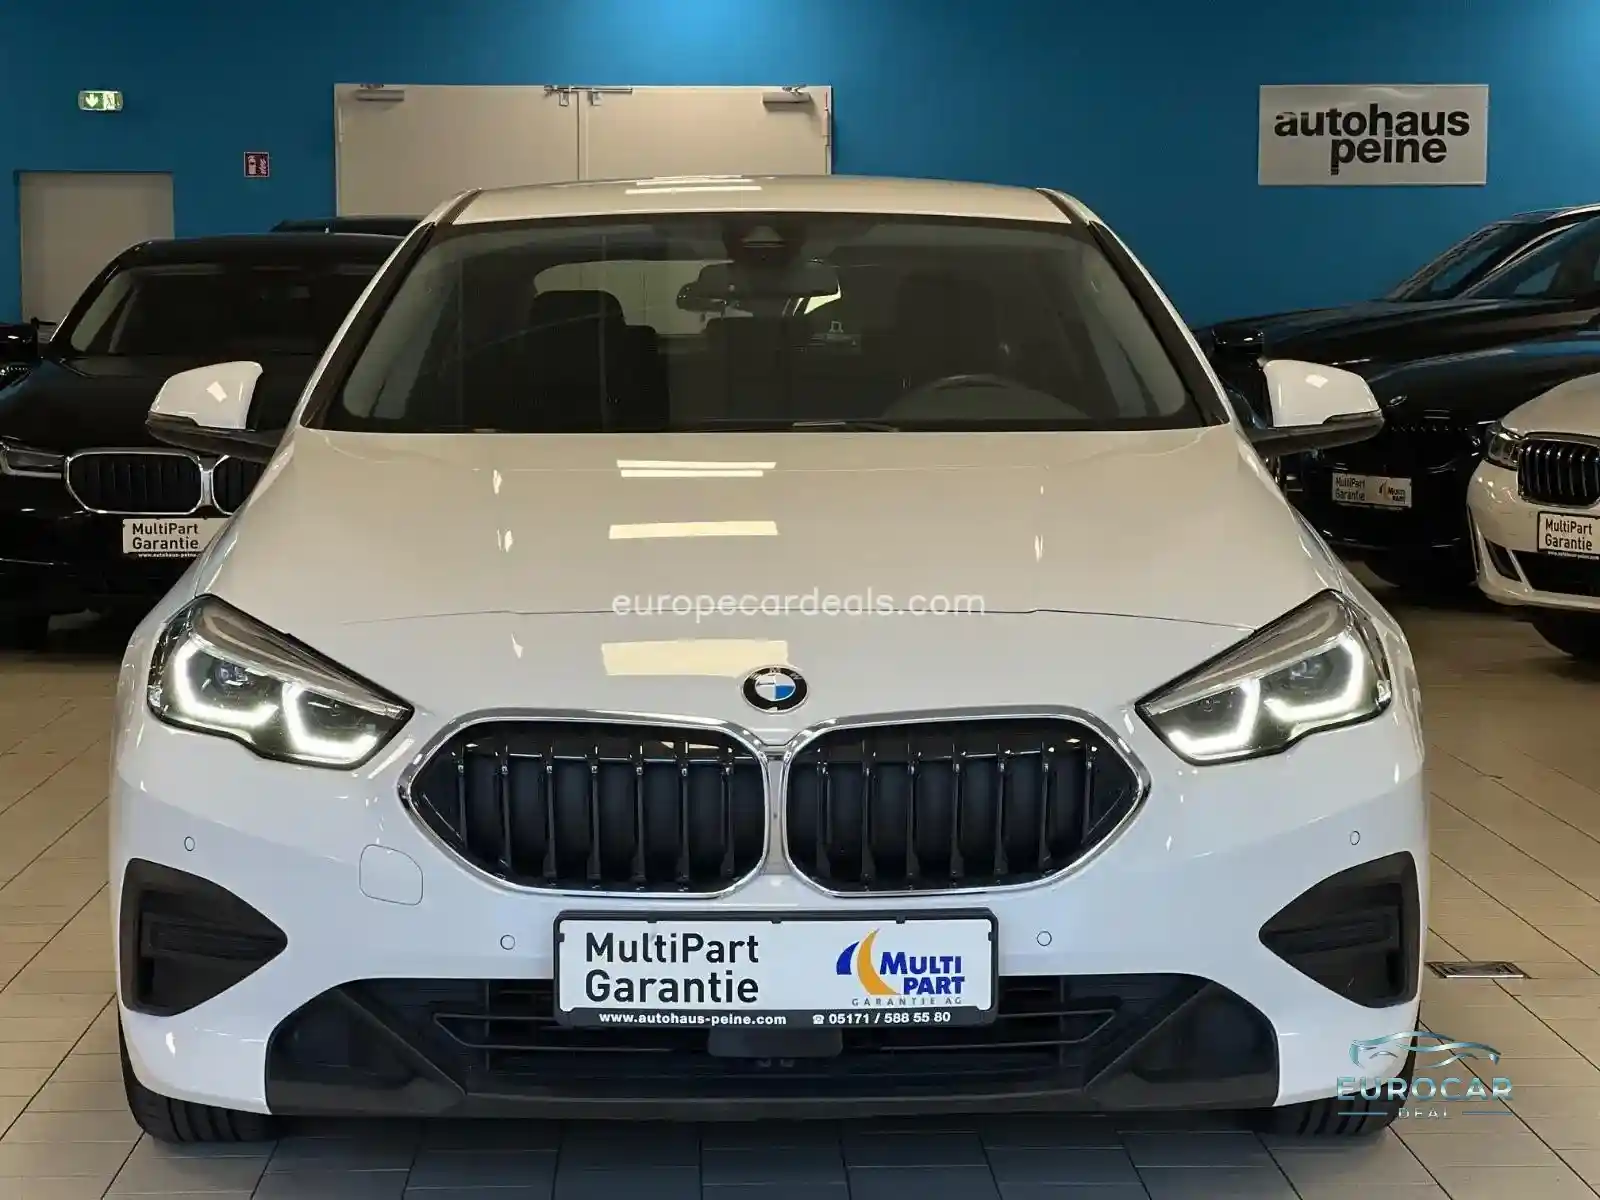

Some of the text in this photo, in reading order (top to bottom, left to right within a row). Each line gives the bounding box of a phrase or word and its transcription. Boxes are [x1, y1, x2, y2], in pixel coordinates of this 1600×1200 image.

[1274, 103, 1470, 137] autohaus
[1331, 135, 1447, 175] peine
[132, 522, 199, 535] MultiPart
[1545, 518, 1592, 535] MultiPart
[132, 536, 199, 549] Garantie
[1545, 533, 1592, 551] Garantie
[586, 932, 759, 963] MultiPart
[585, 968, 759, 1003] Garantie
[903, 976, 965, 995] PART
[852, 996, 962, 1007] GARANTIE AG
[599, 1012, 788, 1027] www.autohaus-peine.com
[828, 1013, 870, 1025] 05171
[884, 1012, 910, 1023] 588
[913, 1012, 930, 1023] 55
[933, 1011, 951, 1023] 80
